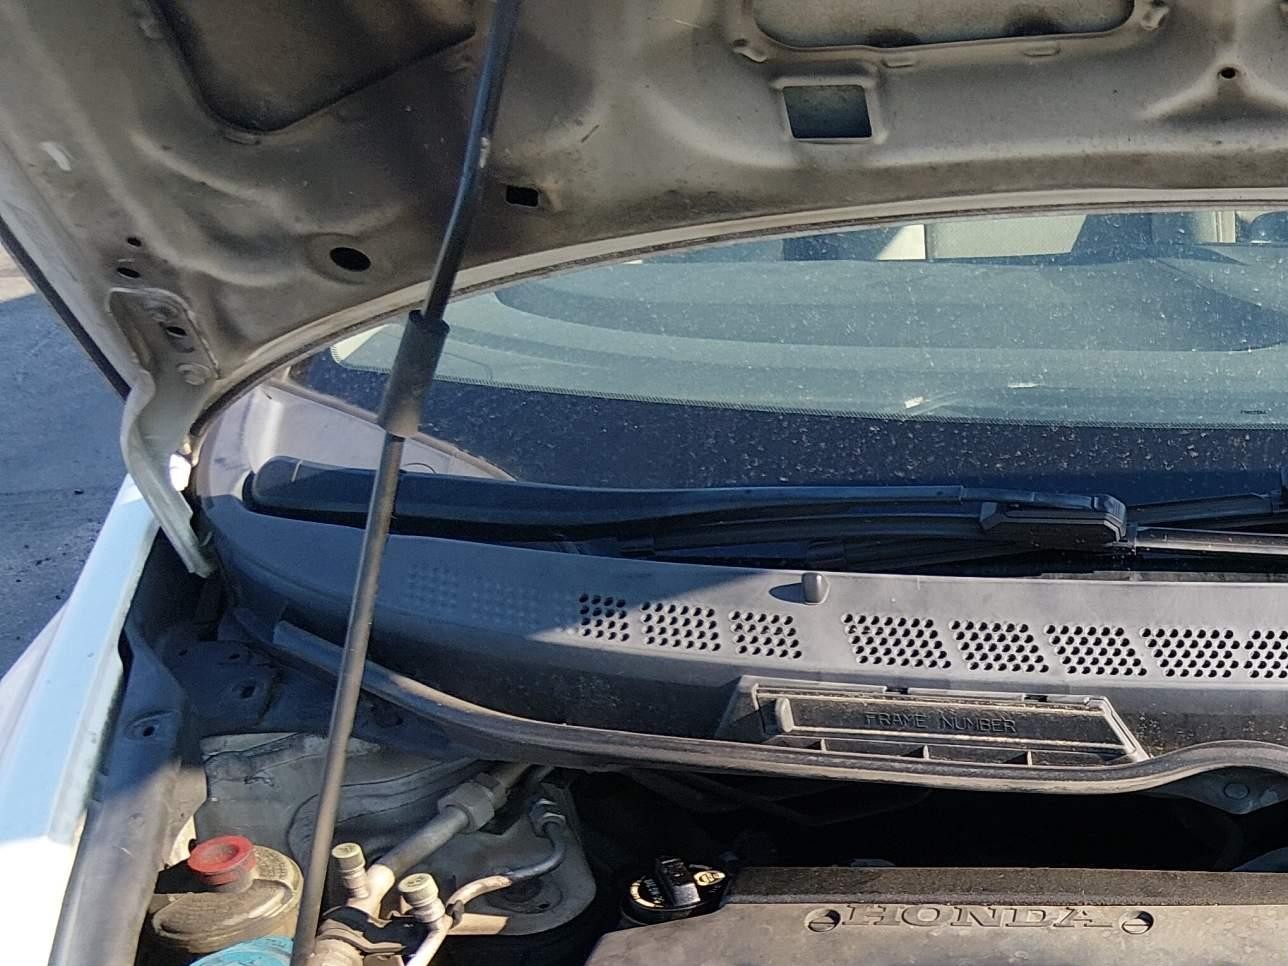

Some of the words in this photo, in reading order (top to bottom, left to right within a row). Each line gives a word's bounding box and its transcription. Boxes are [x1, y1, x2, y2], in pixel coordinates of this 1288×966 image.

[864, 711, 928, 729] FRAME
[938, 715, 1016, 733] NUMBER
[841, 903, 1113, 929] HONDA
